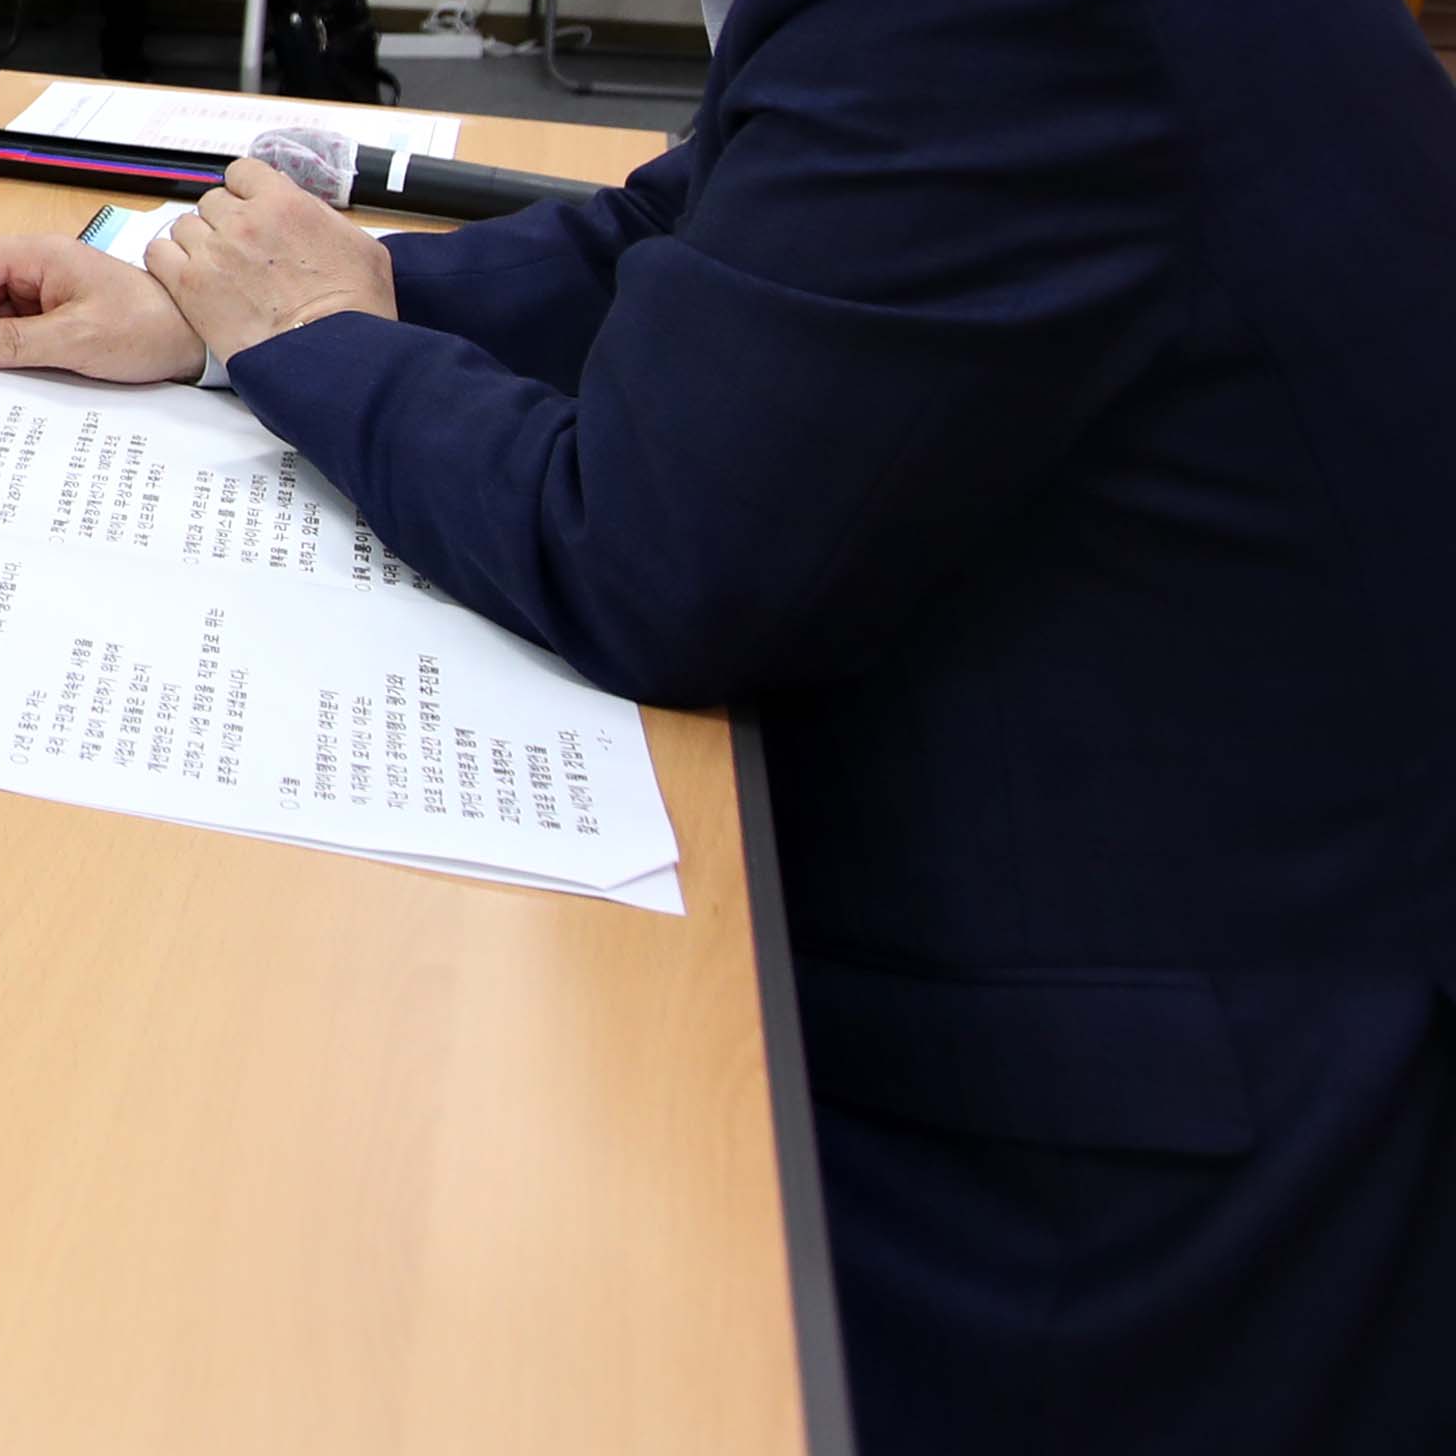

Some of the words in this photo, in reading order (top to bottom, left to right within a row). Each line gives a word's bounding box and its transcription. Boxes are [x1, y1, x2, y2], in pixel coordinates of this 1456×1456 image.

[273, 512, 291, 541] 누리는
[354, 532, 372, 563] 교통이
[205, 608, 224, 628] 뛰는
[101, 643, 122, 672] 위하여
[202, 634, 220, 653] 발로
[129, 664, 152, 692] 없는지
[198, 659, 218, 679] 직접
[91, 678, 115, 714] 추진하기
[192, 684, 215, 712] 현장을
[386, 674, 406, 706] 평가와
[318, 690, 338, 729] 여러분이
[352, 696, 372, 725] 이유는
[352, 730, 372, 760] 모이신
[421, 737, 442, 762] 2년간
[314, 734, 337, 800] 공약이행평가단
[351, 763, 371, 792] 자리에
[422, 766, 444, 784] 남은
[280, 777, 300, 796] 오늘
[350, 795, 371, 805] 이
